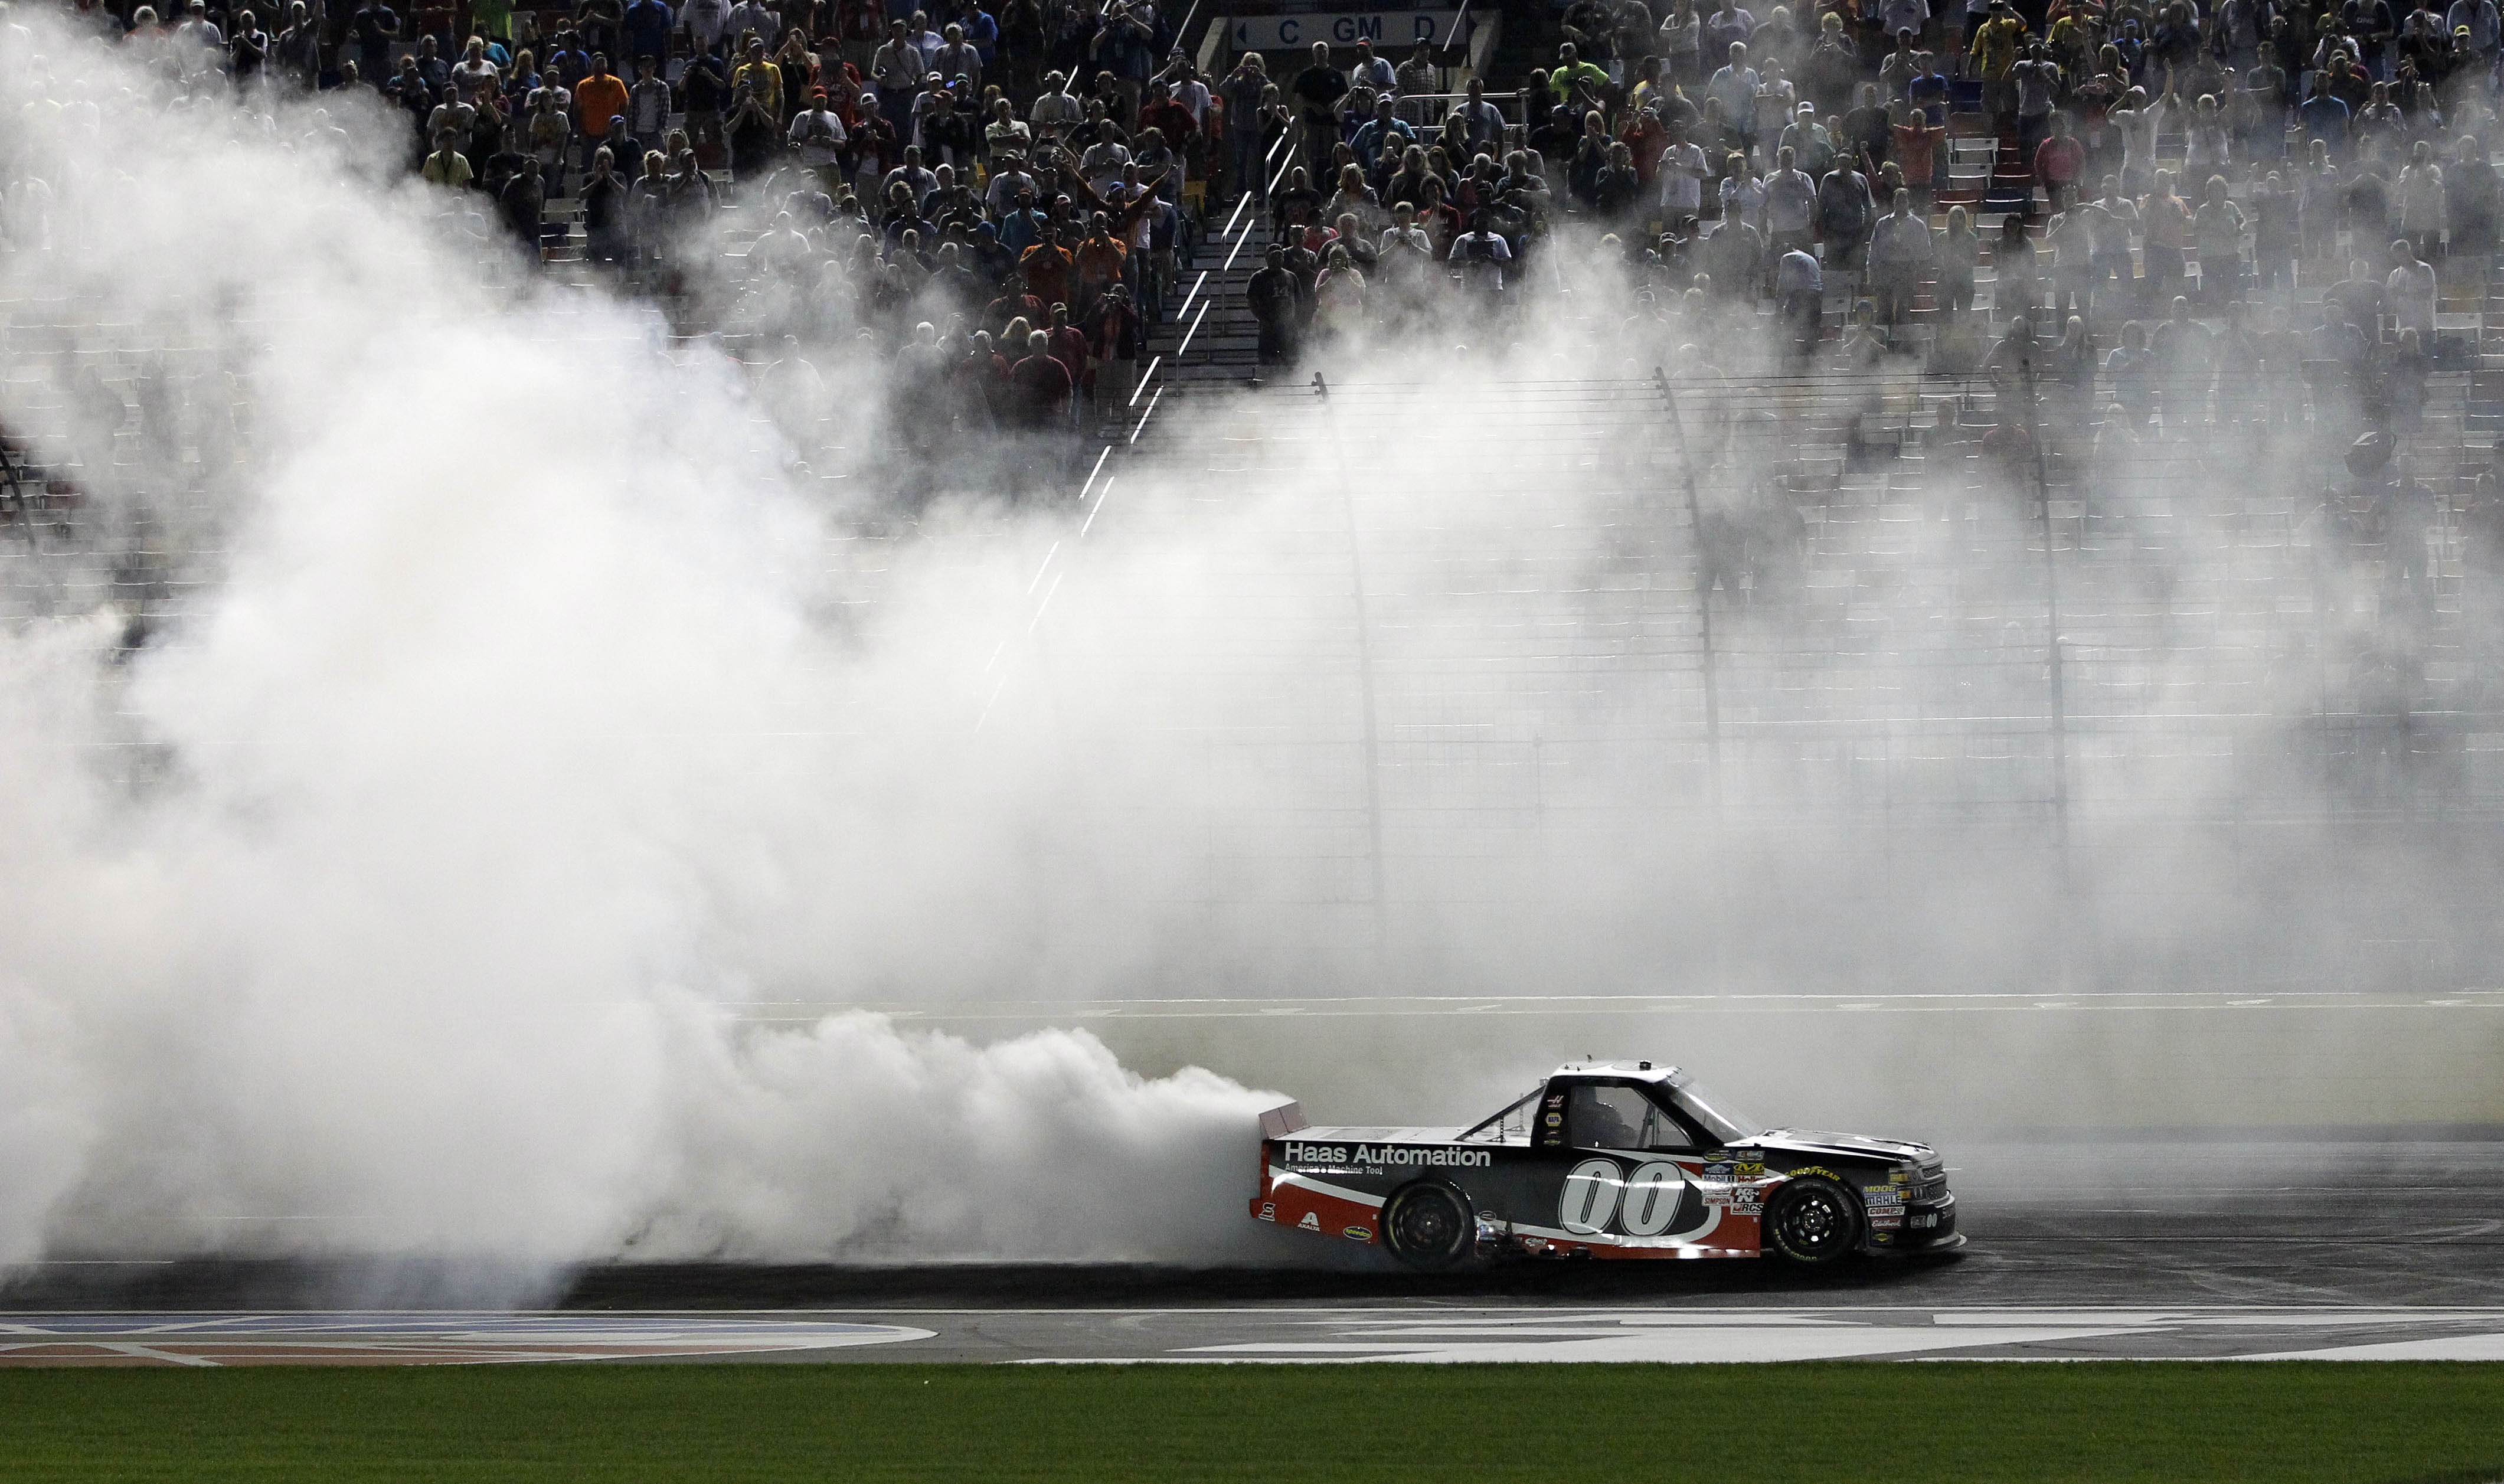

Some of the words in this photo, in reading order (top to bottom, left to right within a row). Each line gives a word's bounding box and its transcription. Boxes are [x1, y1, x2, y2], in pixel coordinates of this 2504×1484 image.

[1279, 20, 1299, 44] C
[1333, 17, 1381, 43] GM
[1414, 16, 1435, 40] D
[1284, 1142, 1348, 1162] Haas
[1353, 1144, 1491, 1167] Automation
[1285, 1163, 1327, 1173] America's
[1328, 1165, 1364, 1174] Machine
[1784, 1166, 1841, 1181] GOODYEAR
[1558, 1158, 1685, 1237] 00
[1865, 1196, 1901, 1205] MAHLE
[1297, 1222, 1320, 1232] AXALTA
